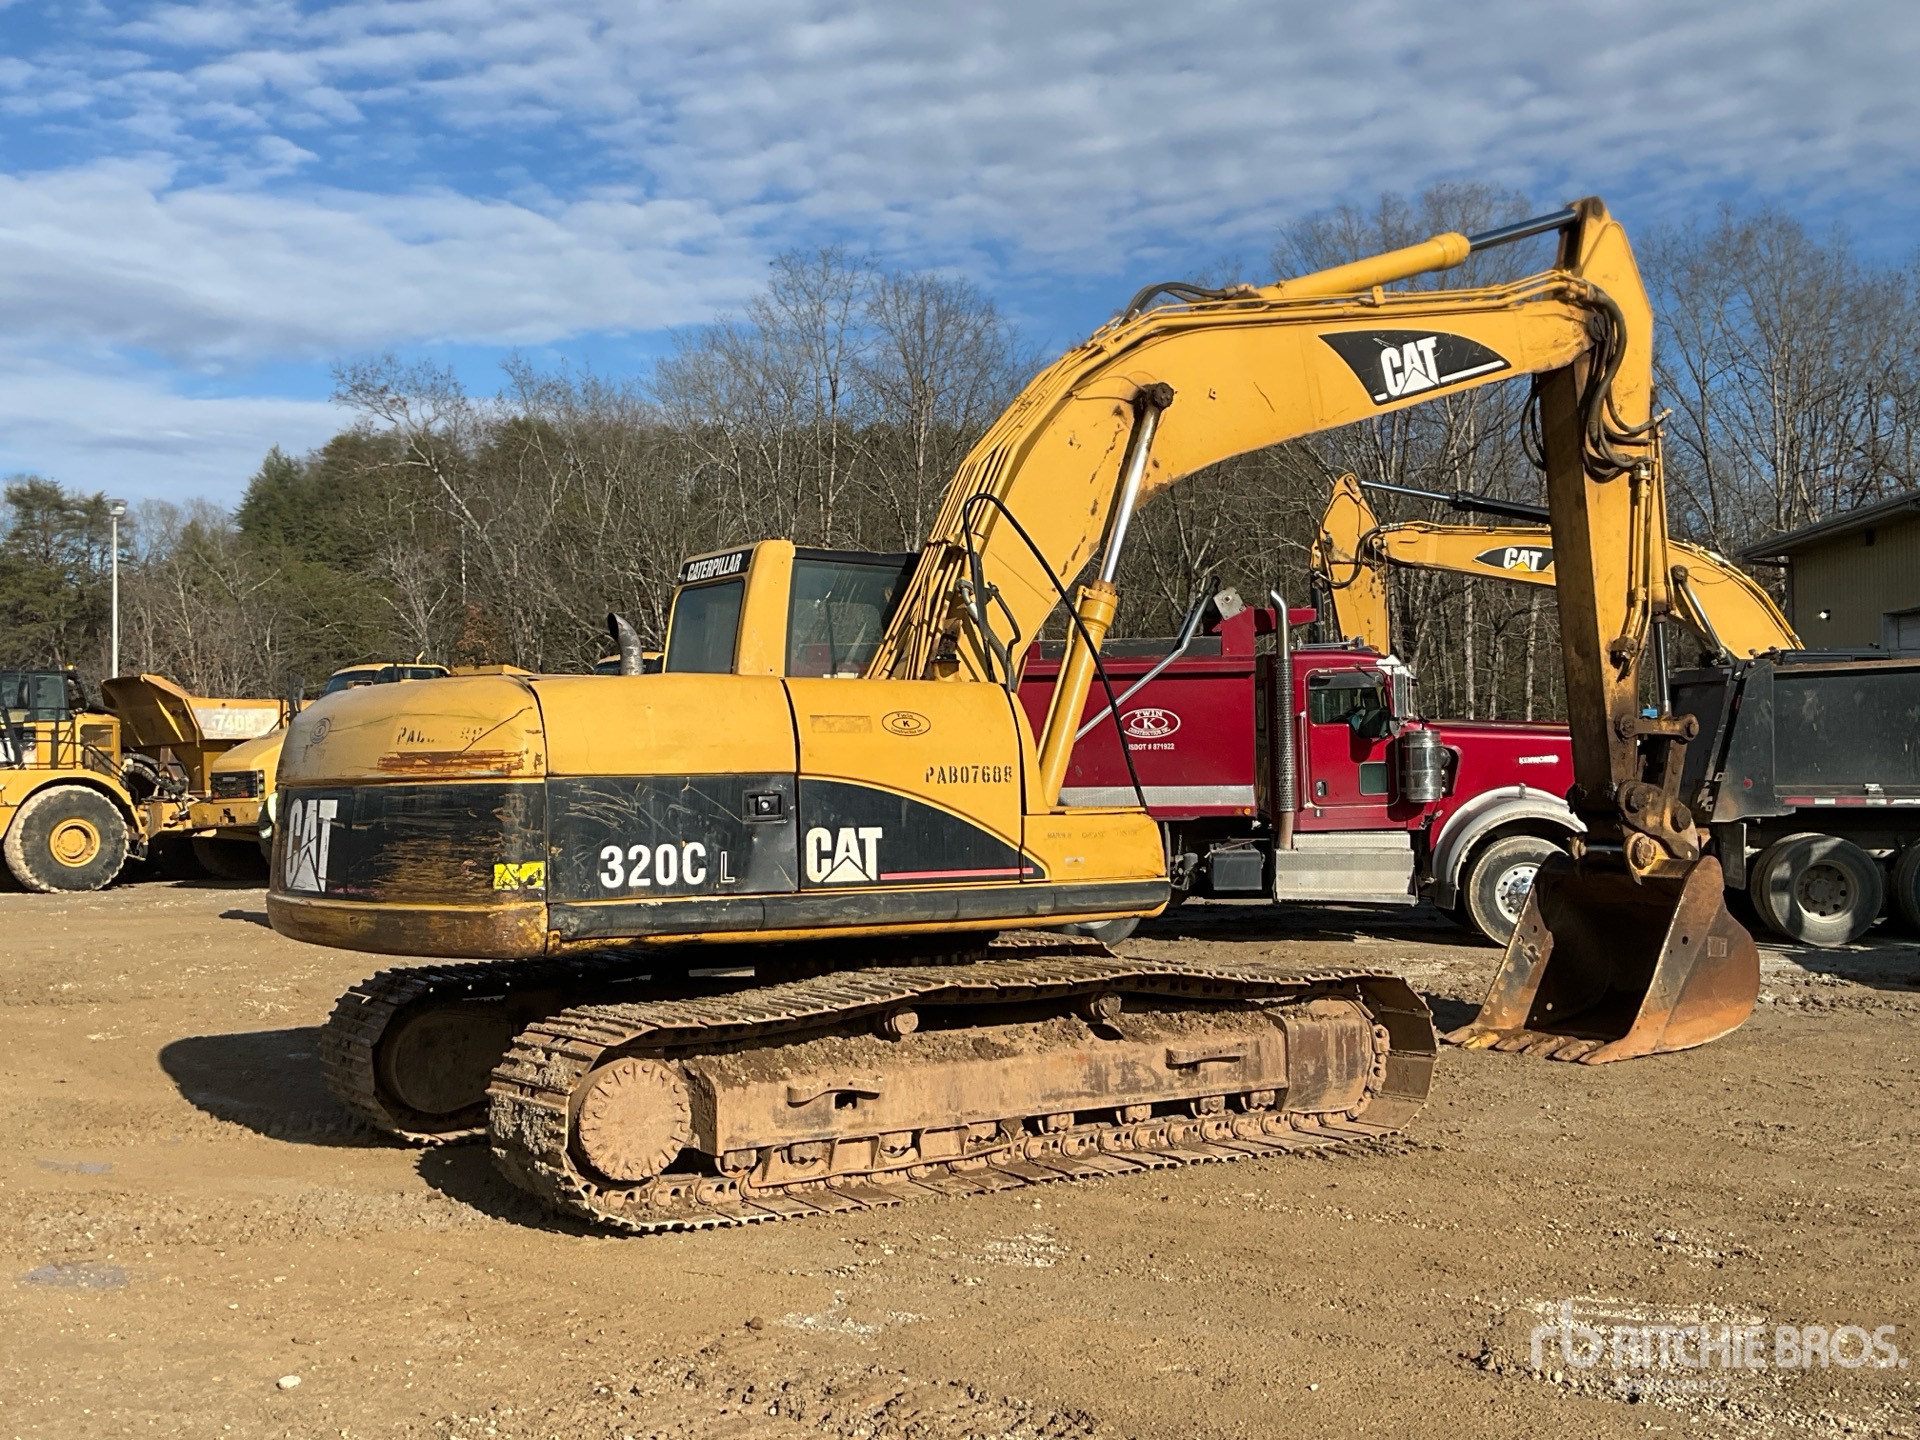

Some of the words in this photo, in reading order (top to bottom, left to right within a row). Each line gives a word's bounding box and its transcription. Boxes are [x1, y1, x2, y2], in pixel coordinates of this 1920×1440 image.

[1380, 336, 1440, 396] CAT
[686, 553, 743, 582] CATERPILLAR
[1503, 547, 1543, 572] CAT
[1135, 710, 1163, 718] TWIN
[1142, 718, 1156, 729] K
[285, 798, 338, 893] CAT
[599, 841, 707, 888] 320C
[720, 850, 736, 883] L
[805, 827, 883, 883] CAT
